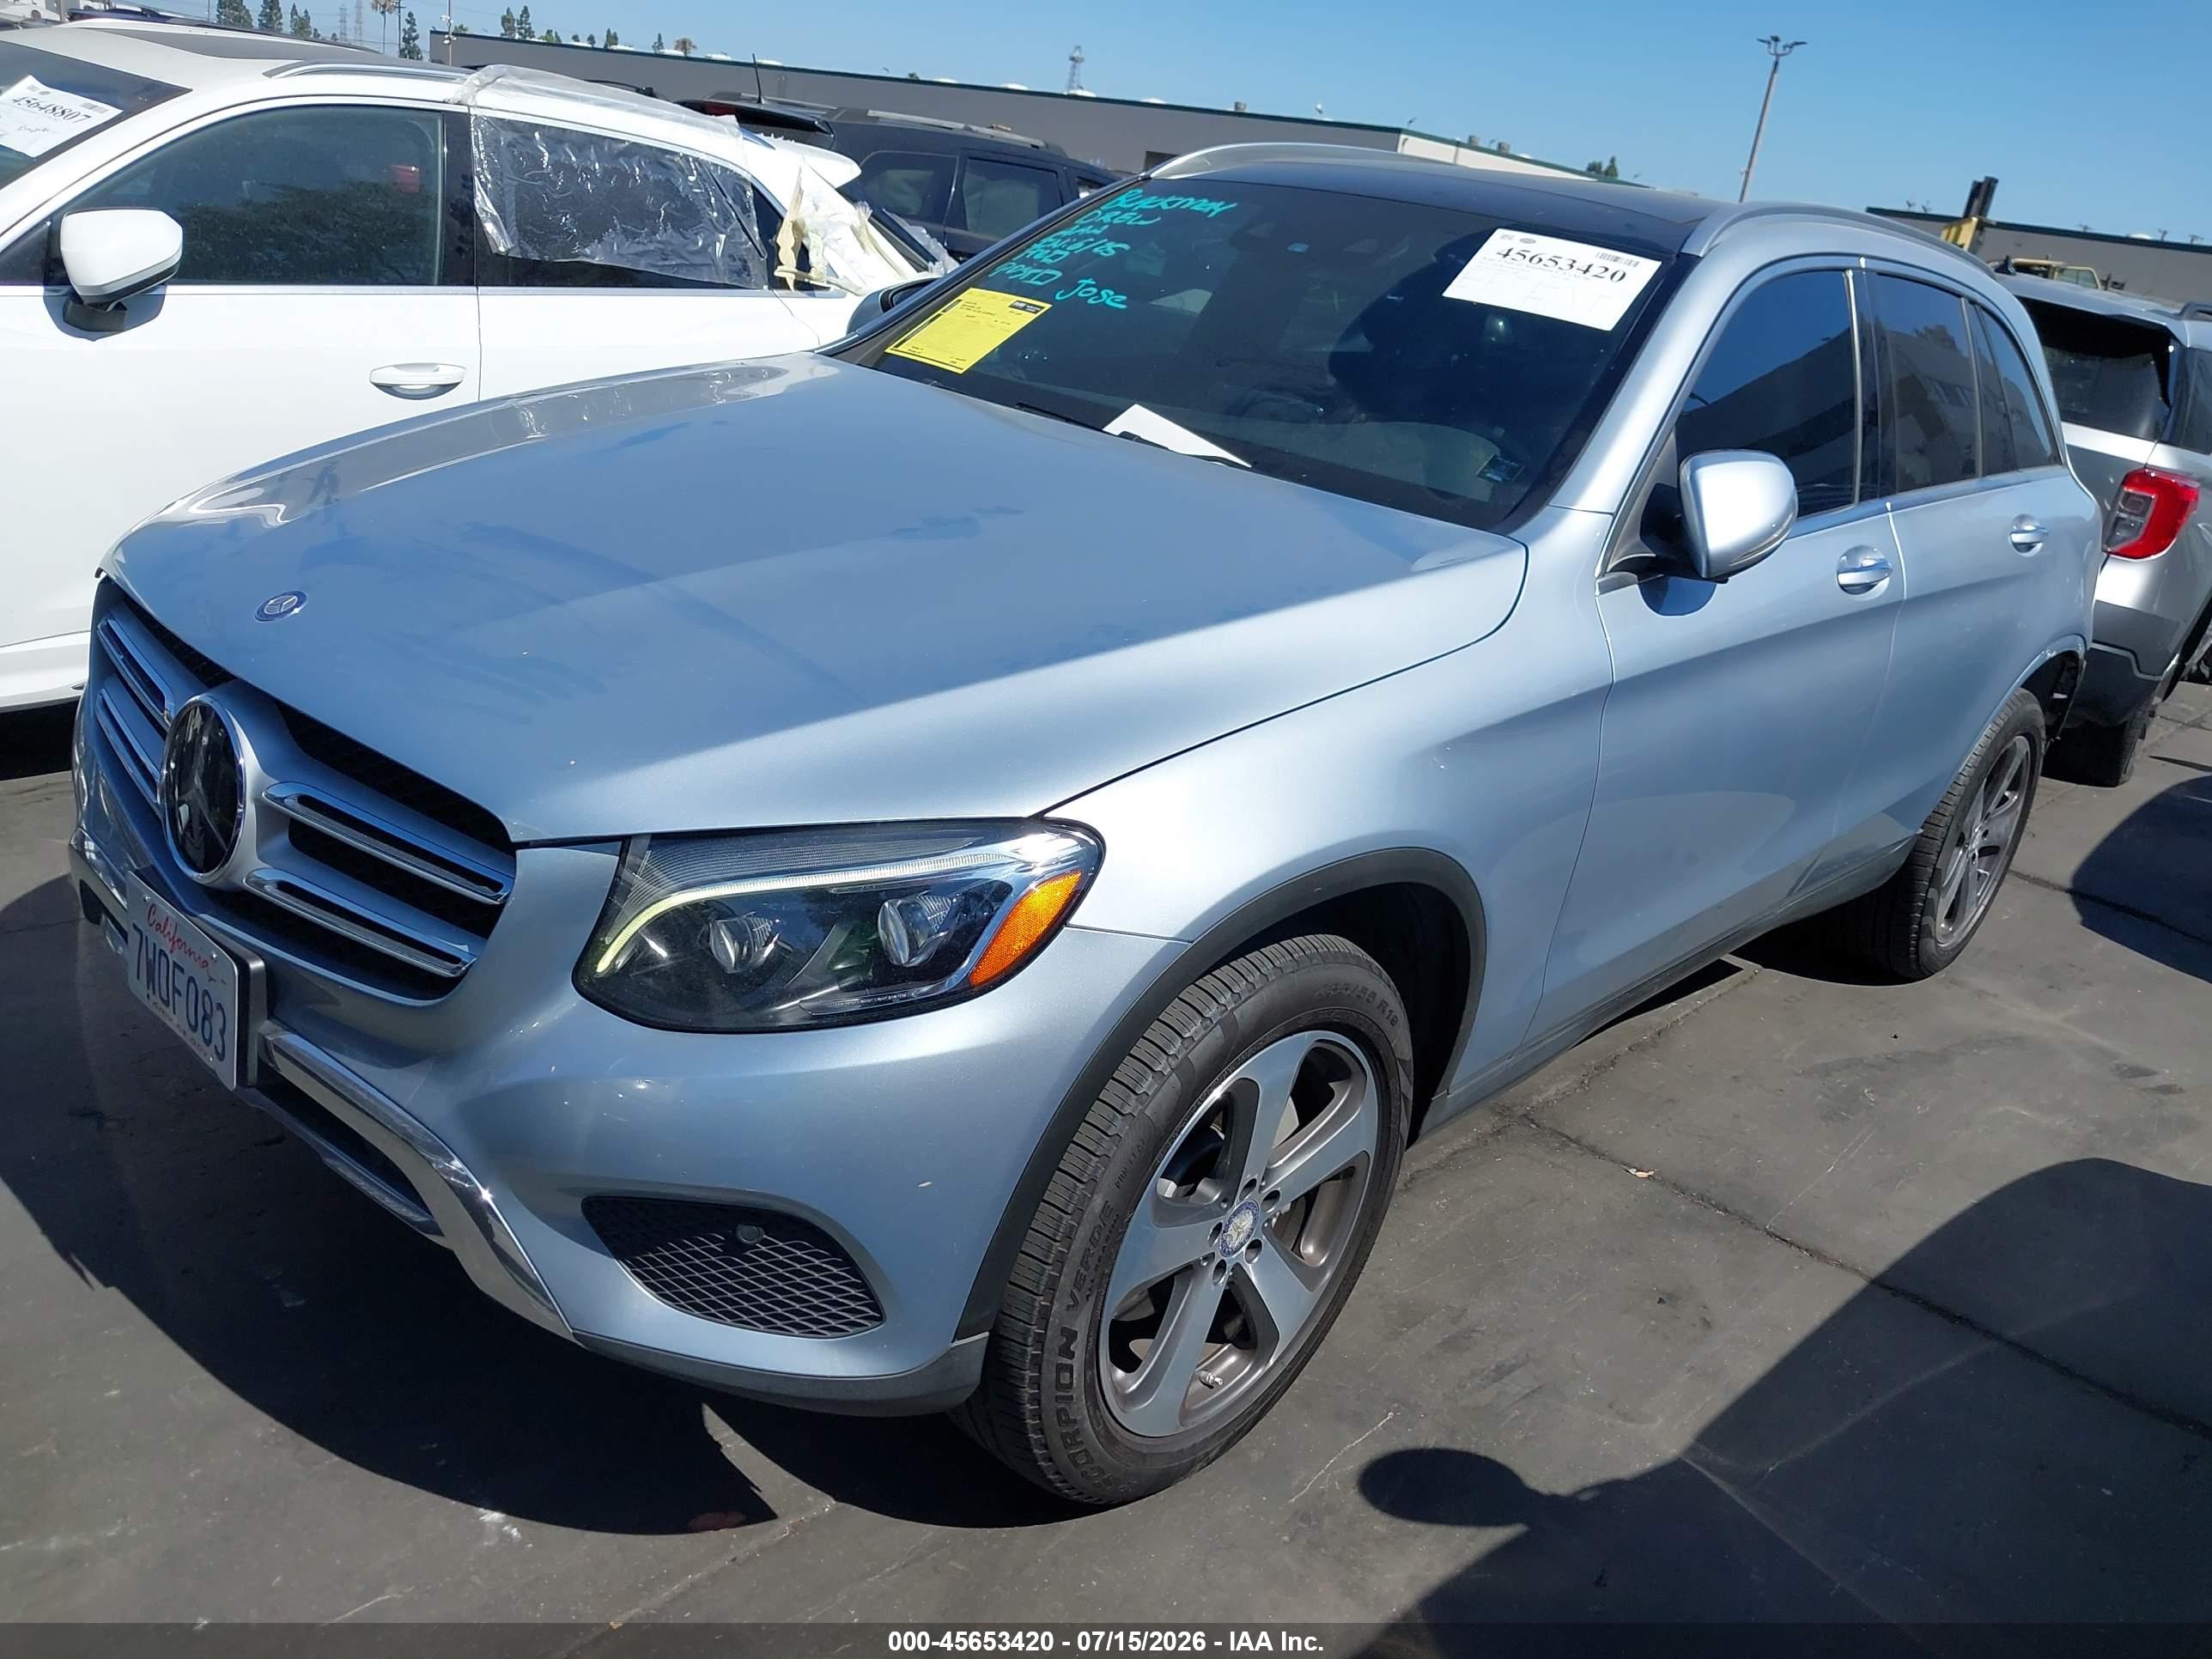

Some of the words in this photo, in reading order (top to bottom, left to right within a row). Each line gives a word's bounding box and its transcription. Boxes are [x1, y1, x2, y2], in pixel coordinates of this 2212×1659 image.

[12, 96, 93, 124] 45648807
[1497, 246, 1627, 283] 45653420
[147, 902, 210, 969] California
[1065, 1200, 1114, 1312] VERDE
[1054, 1326, 1122, 1492] SCORPION
